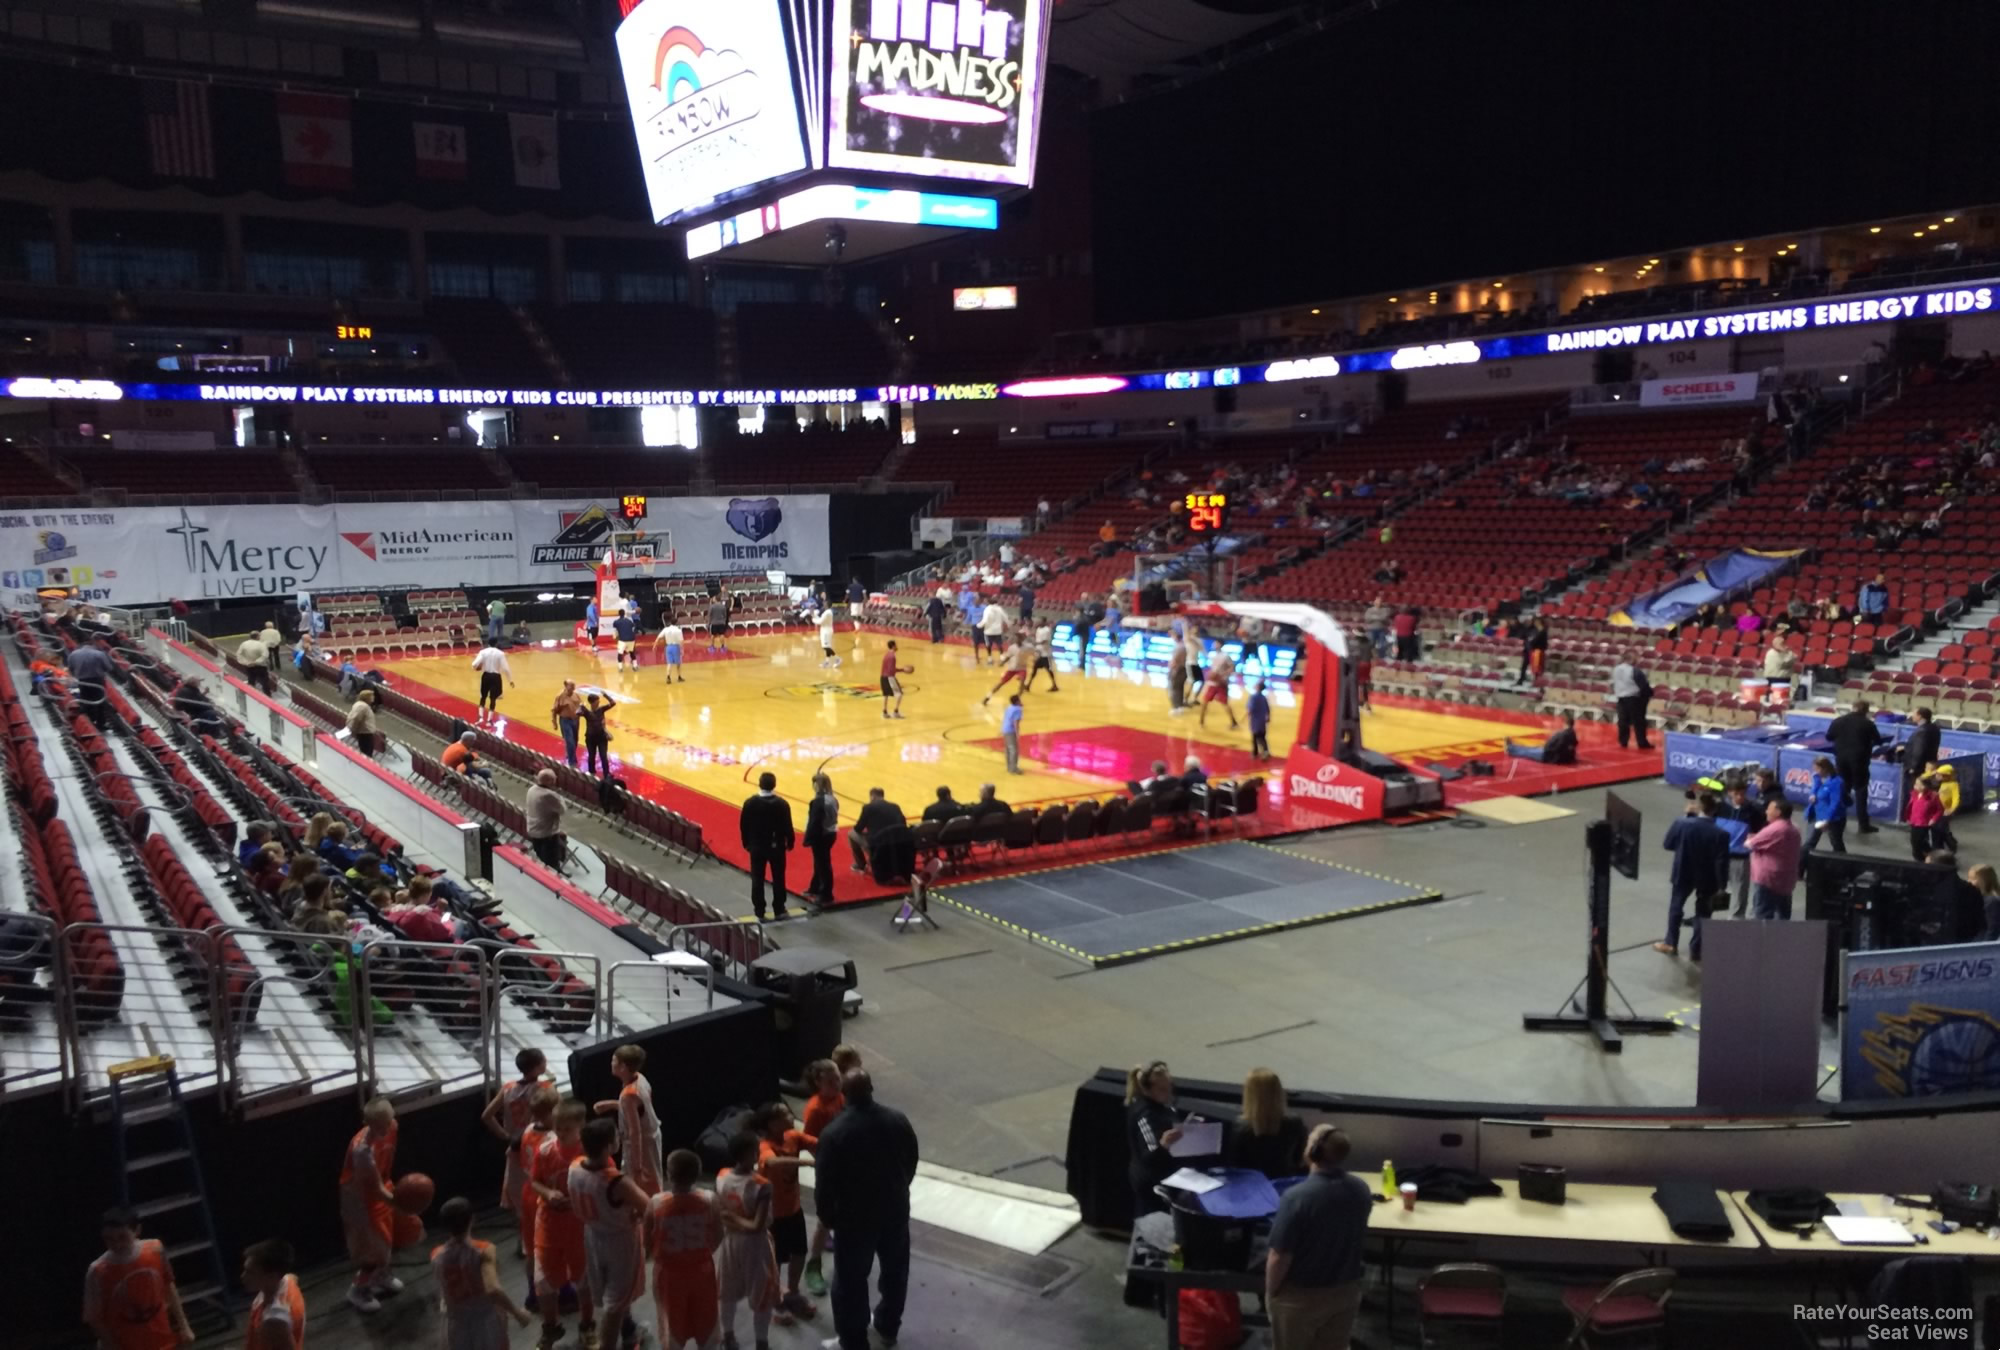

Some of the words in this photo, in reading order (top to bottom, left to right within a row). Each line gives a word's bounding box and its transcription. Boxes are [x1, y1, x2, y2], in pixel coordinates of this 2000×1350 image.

[856, 42, 1017, 108] MADNESS
[1547, 322, 1641, 352] RAINBOW
[1647, 318, 1698, 342] PLAY
[1703, 307, 1807, 338] SYSTEMS
[1814, 295, 1919, 326] ENERGY
[1925, 288, 1992, 315] KIDS
[1668, 350, 1696, 364] 104
[200, 384, 298, 402] RAINBOW
[302, 386, 348, 402] PLAY
[352, 387, 434, 403] SYSTEMS
[438, 388, 508, 403] ENERGY
[512, 390, 551, 404] KIDS
[555, 390, 598, 404] CLUB
[601, 390, 694, 405] PRESENTED
[698, 390, 720, 404] BY
[723, 390, 776, 404] SHEAR
[780, 389, 857, 403] MADNESS
[935, 383, 998, 400] MADNESS
[1662, 380, 1736, 396] SCHEELS
[626, 504, 643, 517] 24
[0, 515, 30, 528] SOCIAL
[34, 515, 58, 527] WITH
[60, 514, 79, 526] THE
[82, 513, 115, 525] ENERGY
[1190, 507, 1222, 531] 24
[379, 528, 513, 544] MidAmerican
[382, 546, 430, 555] ENERGY
[537, 548, 588, 561] PRAIRIE
[200, 538, 328, 583] Mercy
[1290, 774, 1364, 810] SPALDING
